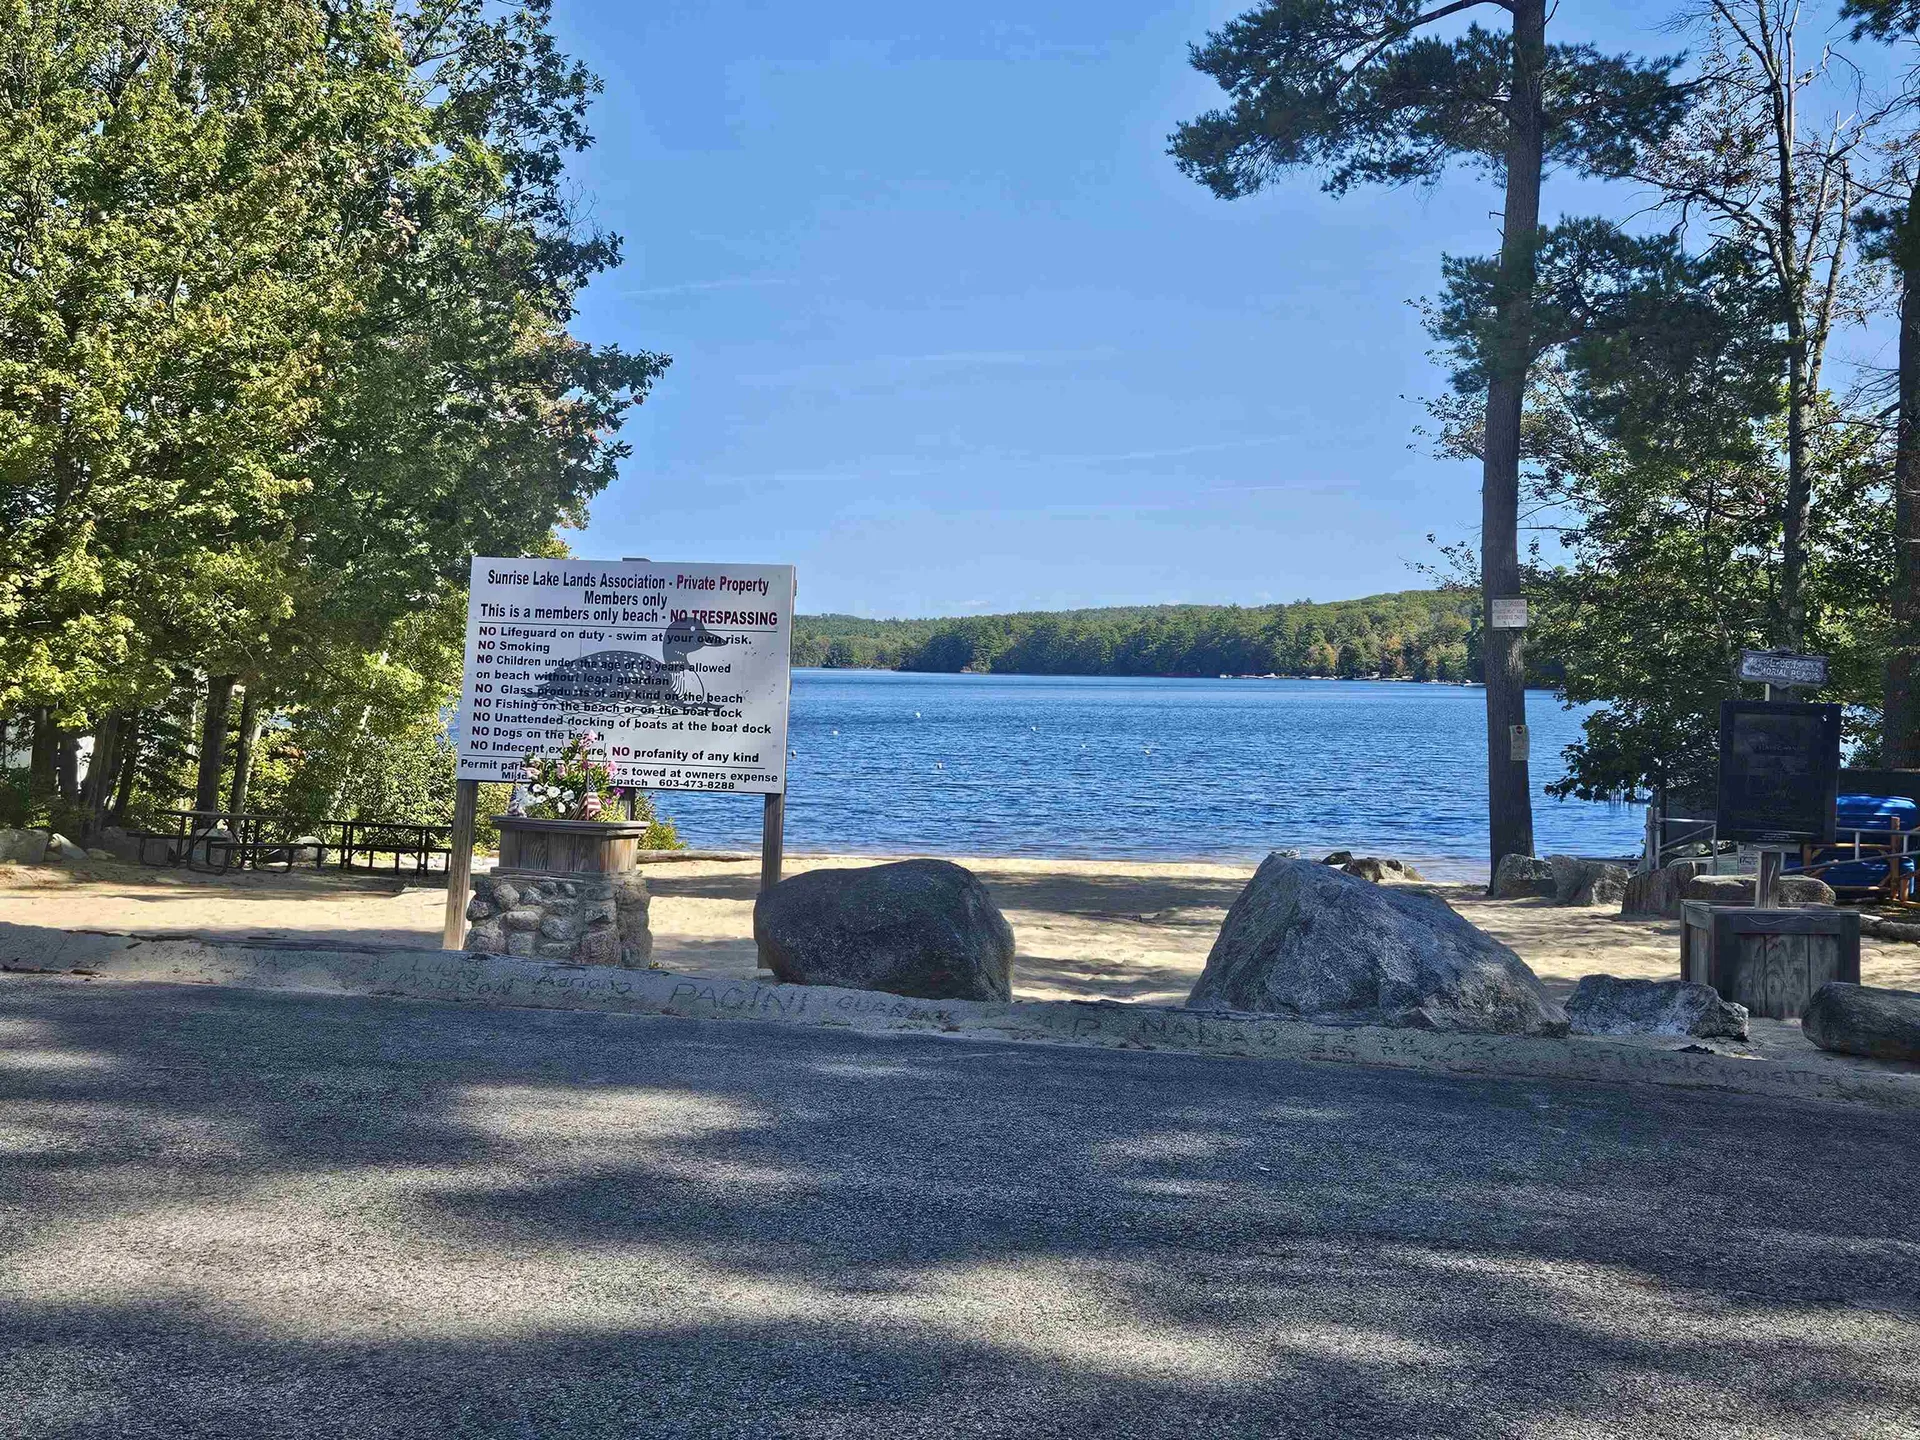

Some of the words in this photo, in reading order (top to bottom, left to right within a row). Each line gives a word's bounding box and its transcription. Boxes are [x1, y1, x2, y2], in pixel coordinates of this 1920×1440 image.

[488, 569, 529, 585] Sunrise
[532, 571, 559, 586] Lake
[563, 571, 596, 587] Lands
[599, 573, 665, 588] Association
[676, 574, 716, 590] Private
[719, 576, 769, 596] Property
[584, 591, 638, 605] Members
[642, 592, 667, 610] only
[480, 603, 505, 617] This
[509, 604, 520, 618] is
[523, 607, 531, 618] a
[534, 606, 589, 620] members
[593, 607, 618, 624] only
[622, 608, 657, 622] beach
[670, 609, 688, 622] NO
[692, 610, 778, 625] TRESPASSING
[479, 626, 496, 636] NO
[500, 626, 557, 639] Lifeguard
[560, 629, 574, 639] on
[578, 630, 605, 641] duty
[616, 632, 647, 641] swim
[651, 632, 664, 642] at
[667, 634, 694, 644] your
[697, 636, 722, 644] own
[725, 634, 752, 645] risk.
[478, 640, 496, 650] NO
[499, 641, 550, 654] Smoking
[476, 654, 493, 664] NO
[496, 655, 541, 666] Children
[544, 657, 576, 667] under
[581, 659, 598, 669] the
[600, 661, 621, 671] age
[624, 660, 637, 670] of
[639, 660, 651, 670] 13
[655, 663, 685, 673] years
[688, 663, 731, 673] allowed
[476, 671, 490, 679] on
[495, 670, 530, 680] beach
[534, 672, 579, 682] without
[583, 673, 613, 685] legal
[616, 675, 669, 686] guardian
[475, 683, 493, 693] NO
[500, 684, 534, 694] Glass
[537, 687, 590, 697] products
[594, 688, 607, 698] of
[609, 690, 631, 701] any
[635, 690, 660, 700] kind
[665, 692, 679, 701] on
[682, 692, 704, 702] the
[707, 692, 743, 703] beach
[474, 698, 491, 708] NO
[495, 698, 538, 711] Fishing
[541, 701, 557, 710] on
[560, 701, 580, 711] the
[583, 702, 620, 713] beach
[624, 705, 637, 714] or
[640, 706, 655, 715] on
[659, 705, 679, 716] the
[682, 707, 709, 717] boat
[713, 708, 743, 718] dock
[473, 711, 491, 722] NO
[494, 712, 563, 725] Unattended
[567, 716, 615, 729] docking
[618, 718, 631, 728] of
[634, 719, 668, 730] boats
[671, 721, 684, 731] at
[688, 721, 708, 732] the
[711, 721, 738, 733] boat
[742, 723, 772, 734] dock
[472, 726, 490, 736] NO
[493, 727, 523, 738] Dogs
[526, 729, 541, 738] on
[545, 729, 565, 739] the
[470, 740, 488, 750] NO
[492, 741, 545, 754] Indecent
[612, 746, 631, 757] NO
[633, 747, 689, 762] profanity
[691, 751, 704, 761] of
[707, 752, 730, 764] any
[733, 752, 760, 763] kind
[461, 758, 498, 770] Permit
[631, 767, 667, 778] towed
[669, 768, 682, 778] at
[685, 770, 727, 780] owners
[730, 772, 778, 783] expense
[659, 779, 735, 790] 603-473-8288
